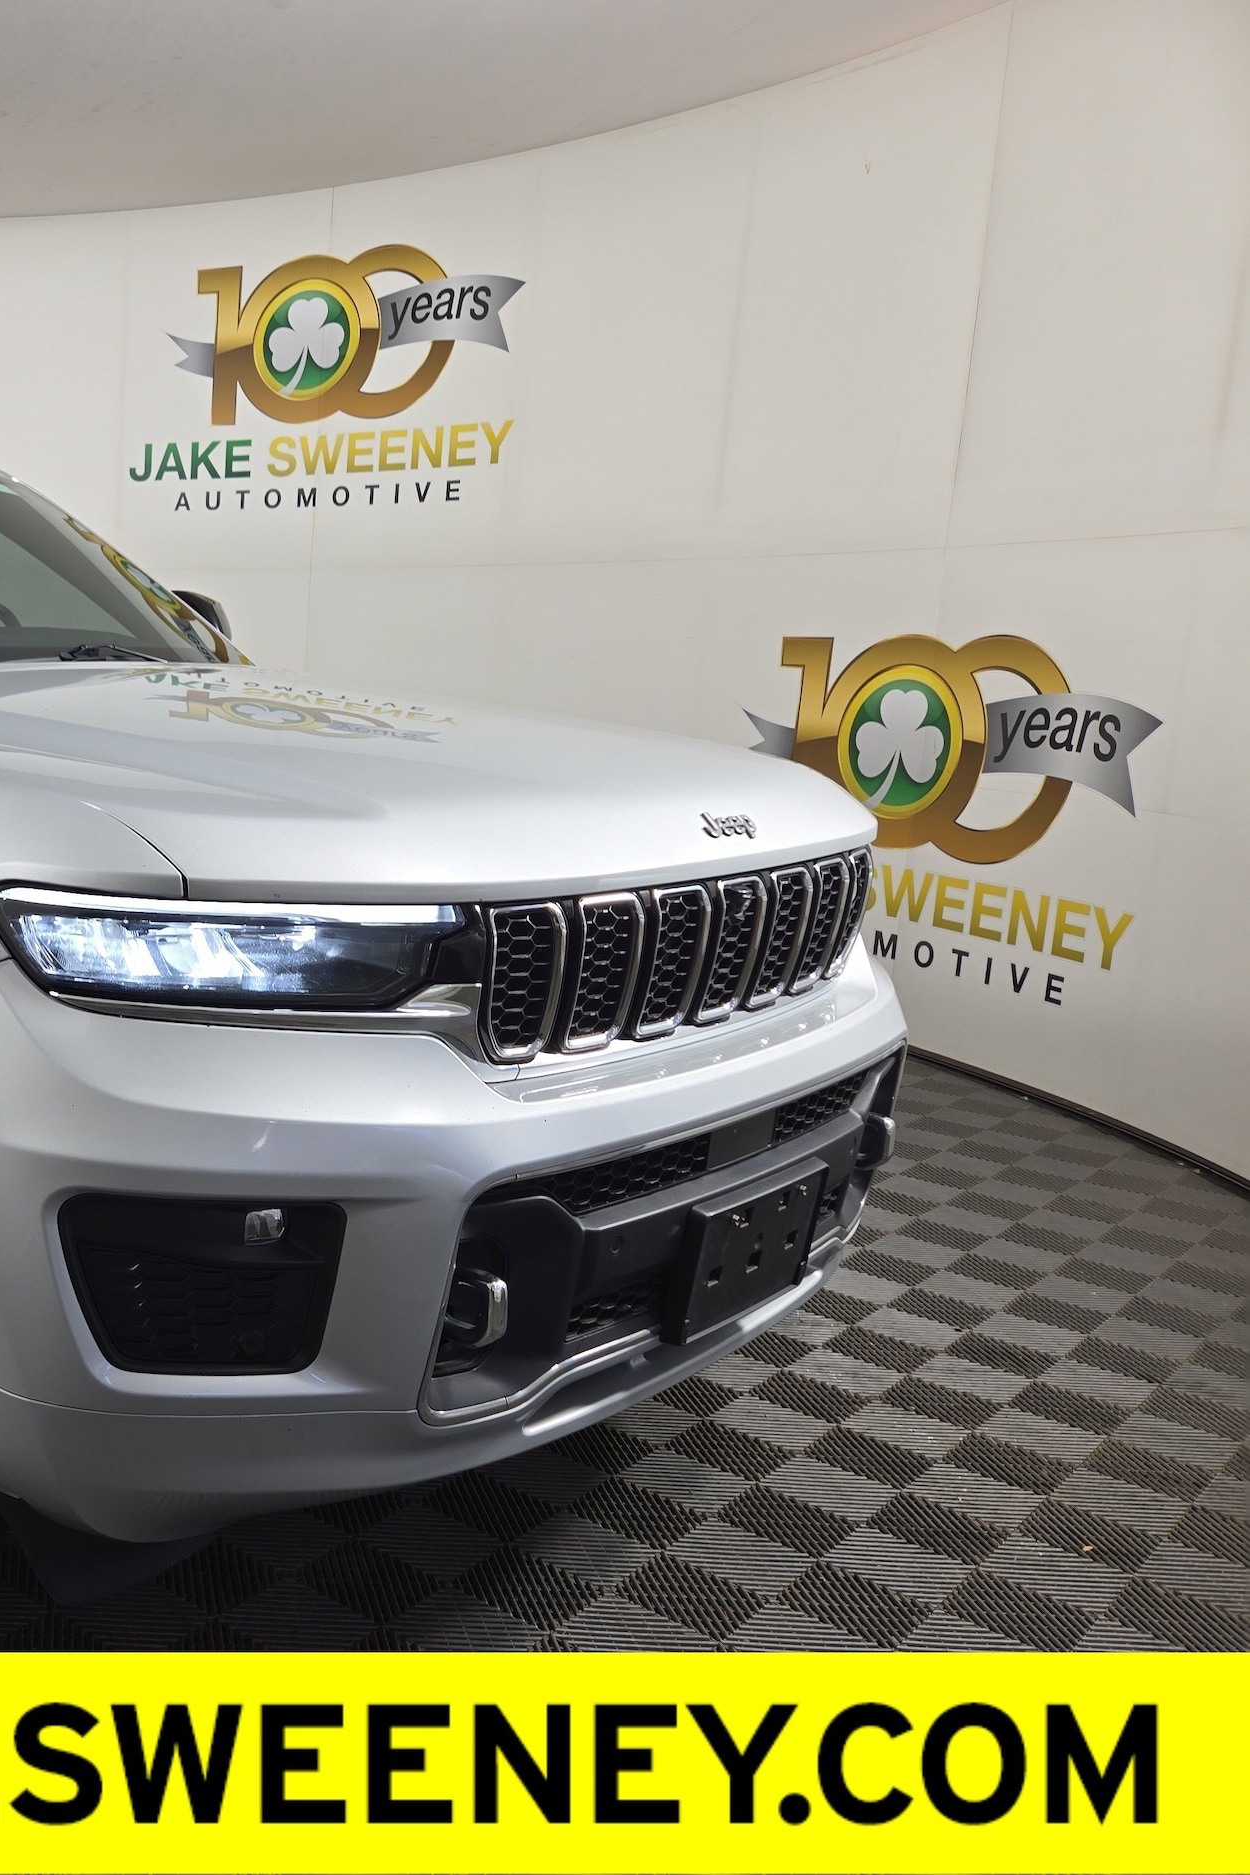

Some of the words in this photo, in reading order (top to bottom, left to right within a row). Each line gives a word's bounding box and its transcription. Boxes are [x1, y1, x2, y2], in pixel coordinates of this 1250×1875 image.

[387, 284, 492, 341] years
[129, 439, 252, 482] JAKE
[266, 419, 514, 478] SWEENEY
[174, 480, 462, 511] AUTOMOTIVE
[993, 705, 1122, 763] years
[699, 811, 757, 839] Jeep
